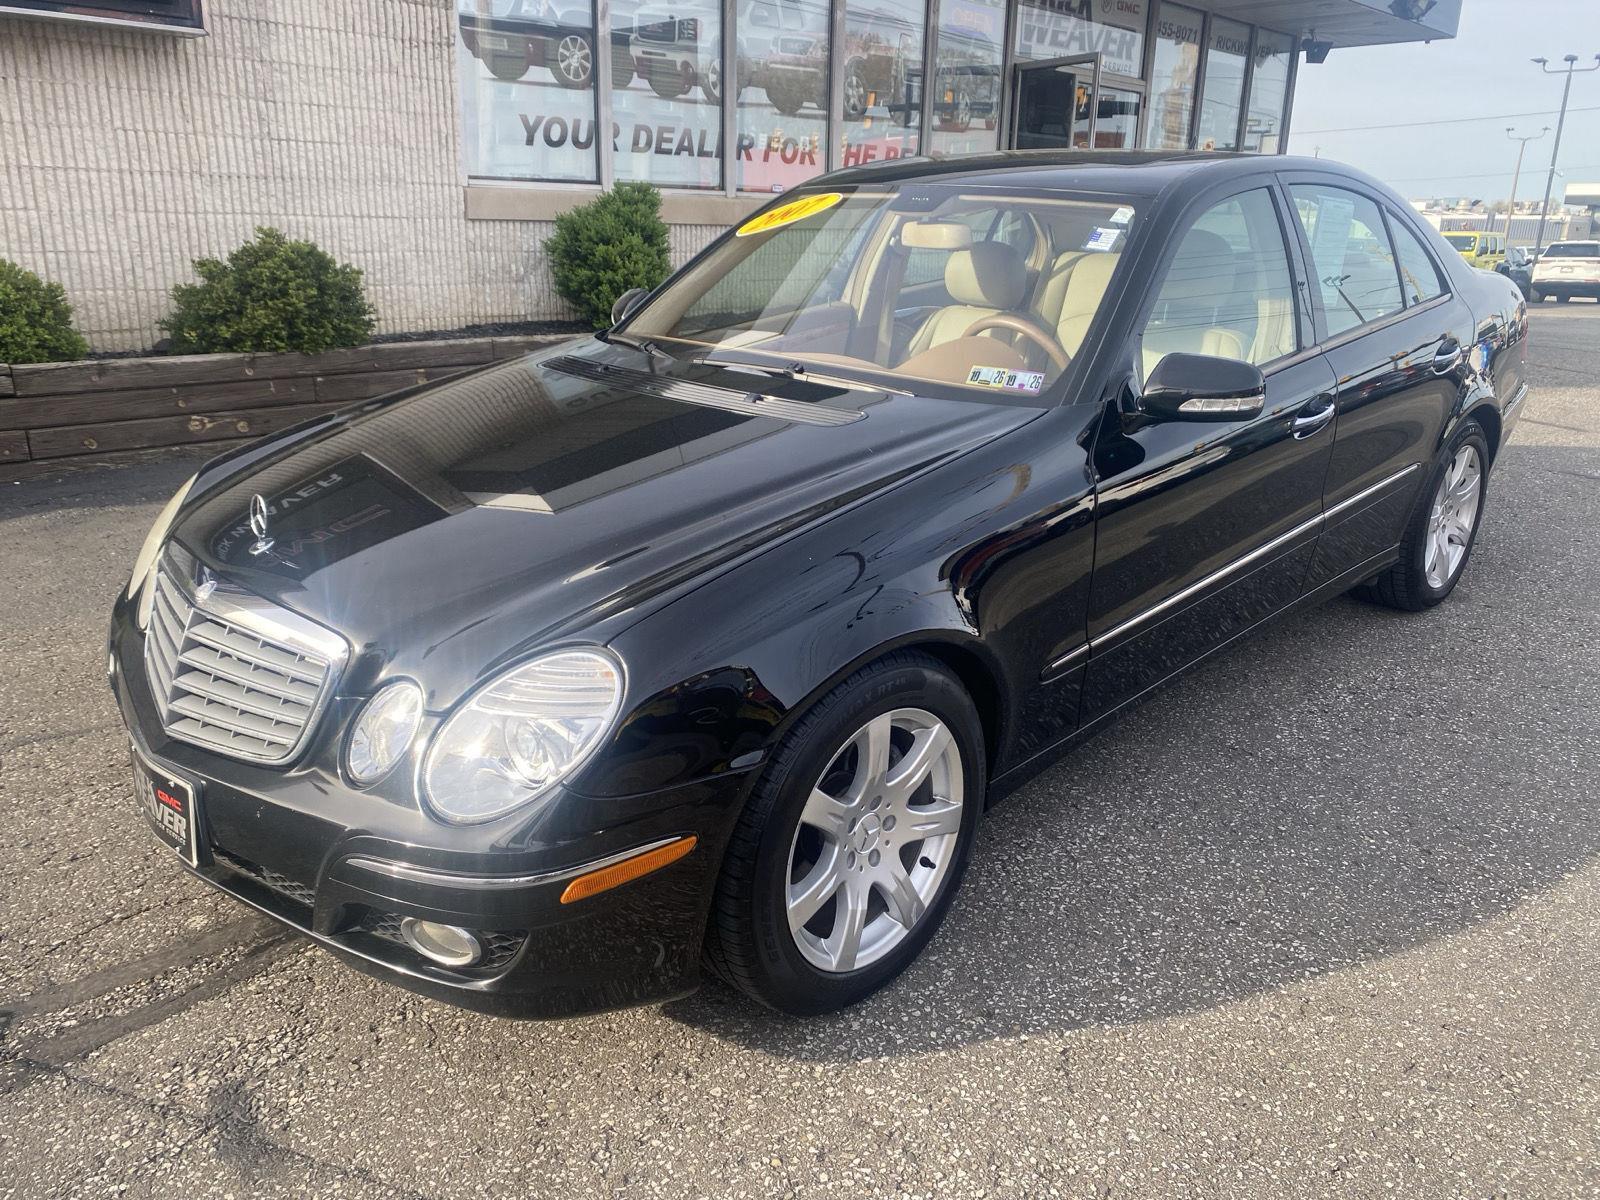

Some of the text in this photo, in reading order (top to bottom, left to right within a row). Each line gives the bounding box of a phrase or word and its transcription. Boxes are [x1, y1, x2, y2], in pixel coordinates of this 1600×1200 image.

[1116, 2, 1141, 14] GMC
[1022, 21, 1137, 61] WEAVER
[763, 136, 816, 166] FOR
[843, 142, 877, 168] HE
[157, 789, 183, 812] GMC
